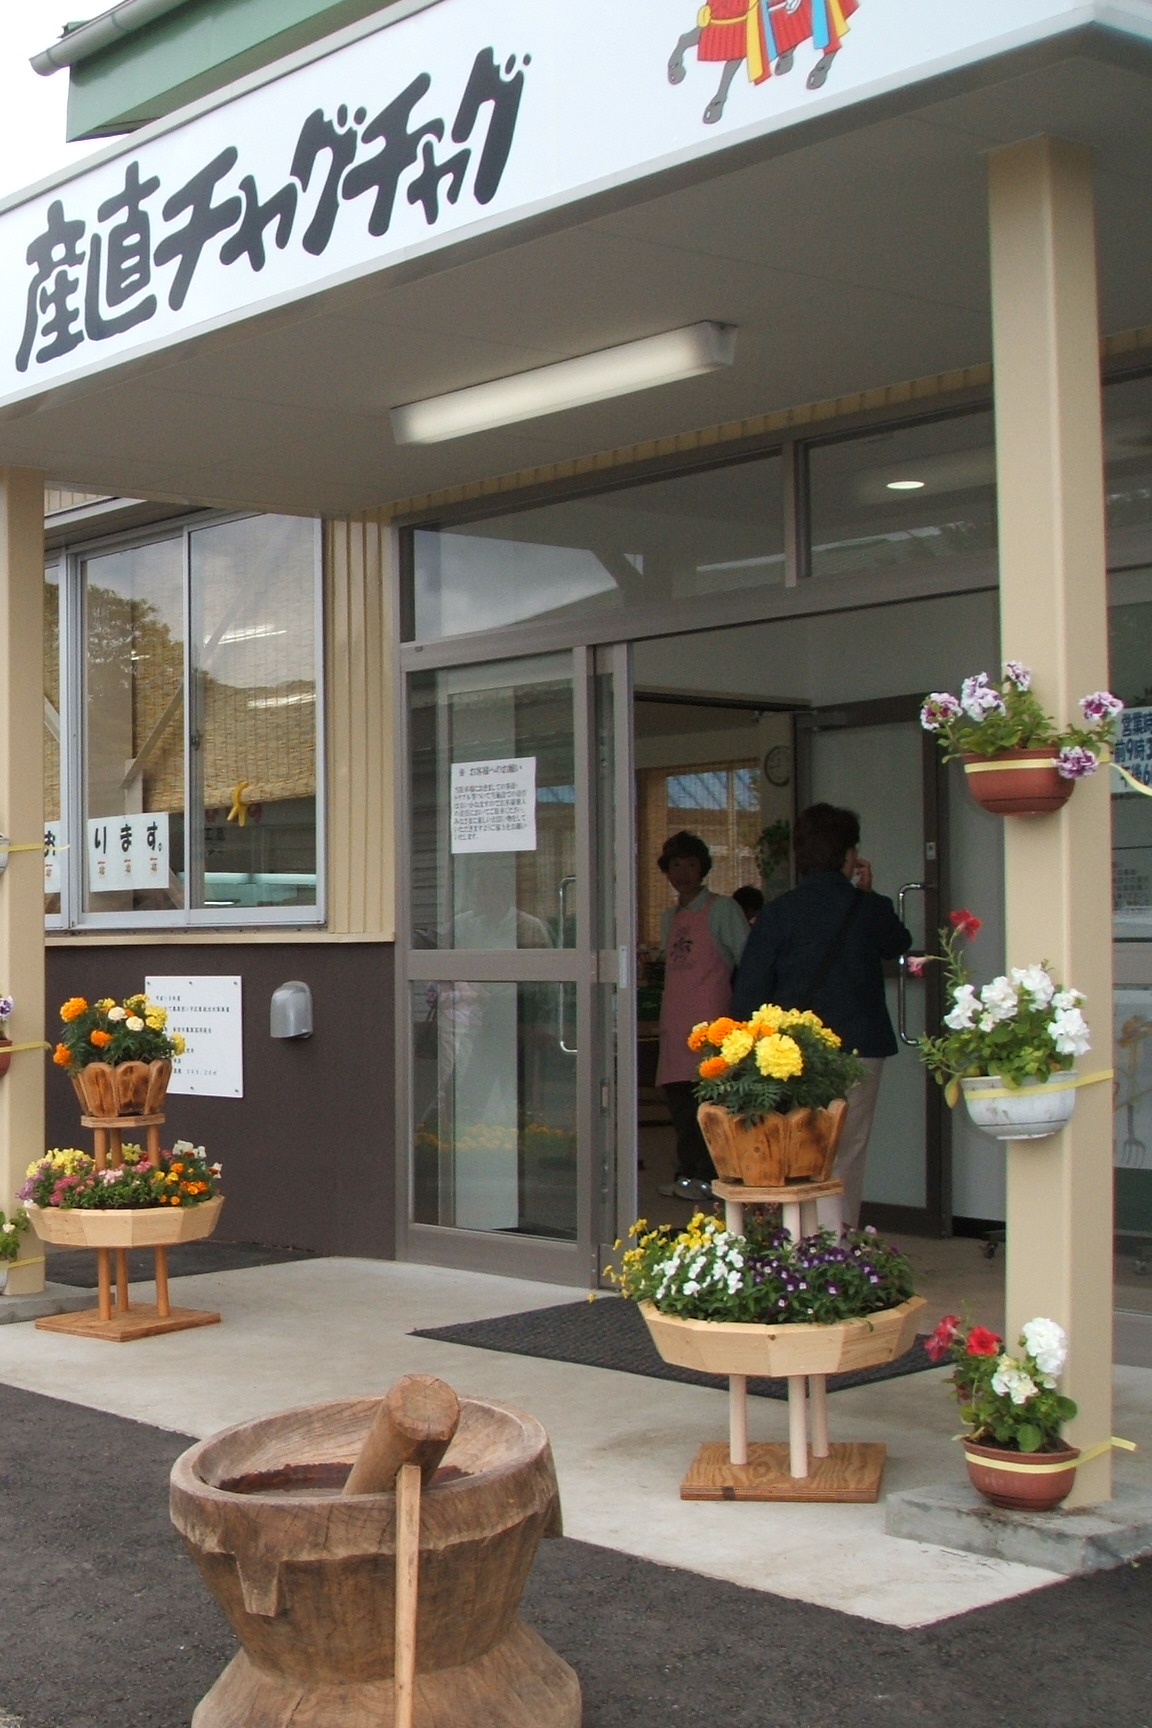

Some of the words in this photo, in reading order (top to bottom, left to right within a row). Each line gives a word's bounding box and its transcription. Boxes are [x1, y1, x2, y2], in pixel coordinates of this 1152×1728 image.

[15, 45, 532, 373] 産直チャグチャグ
